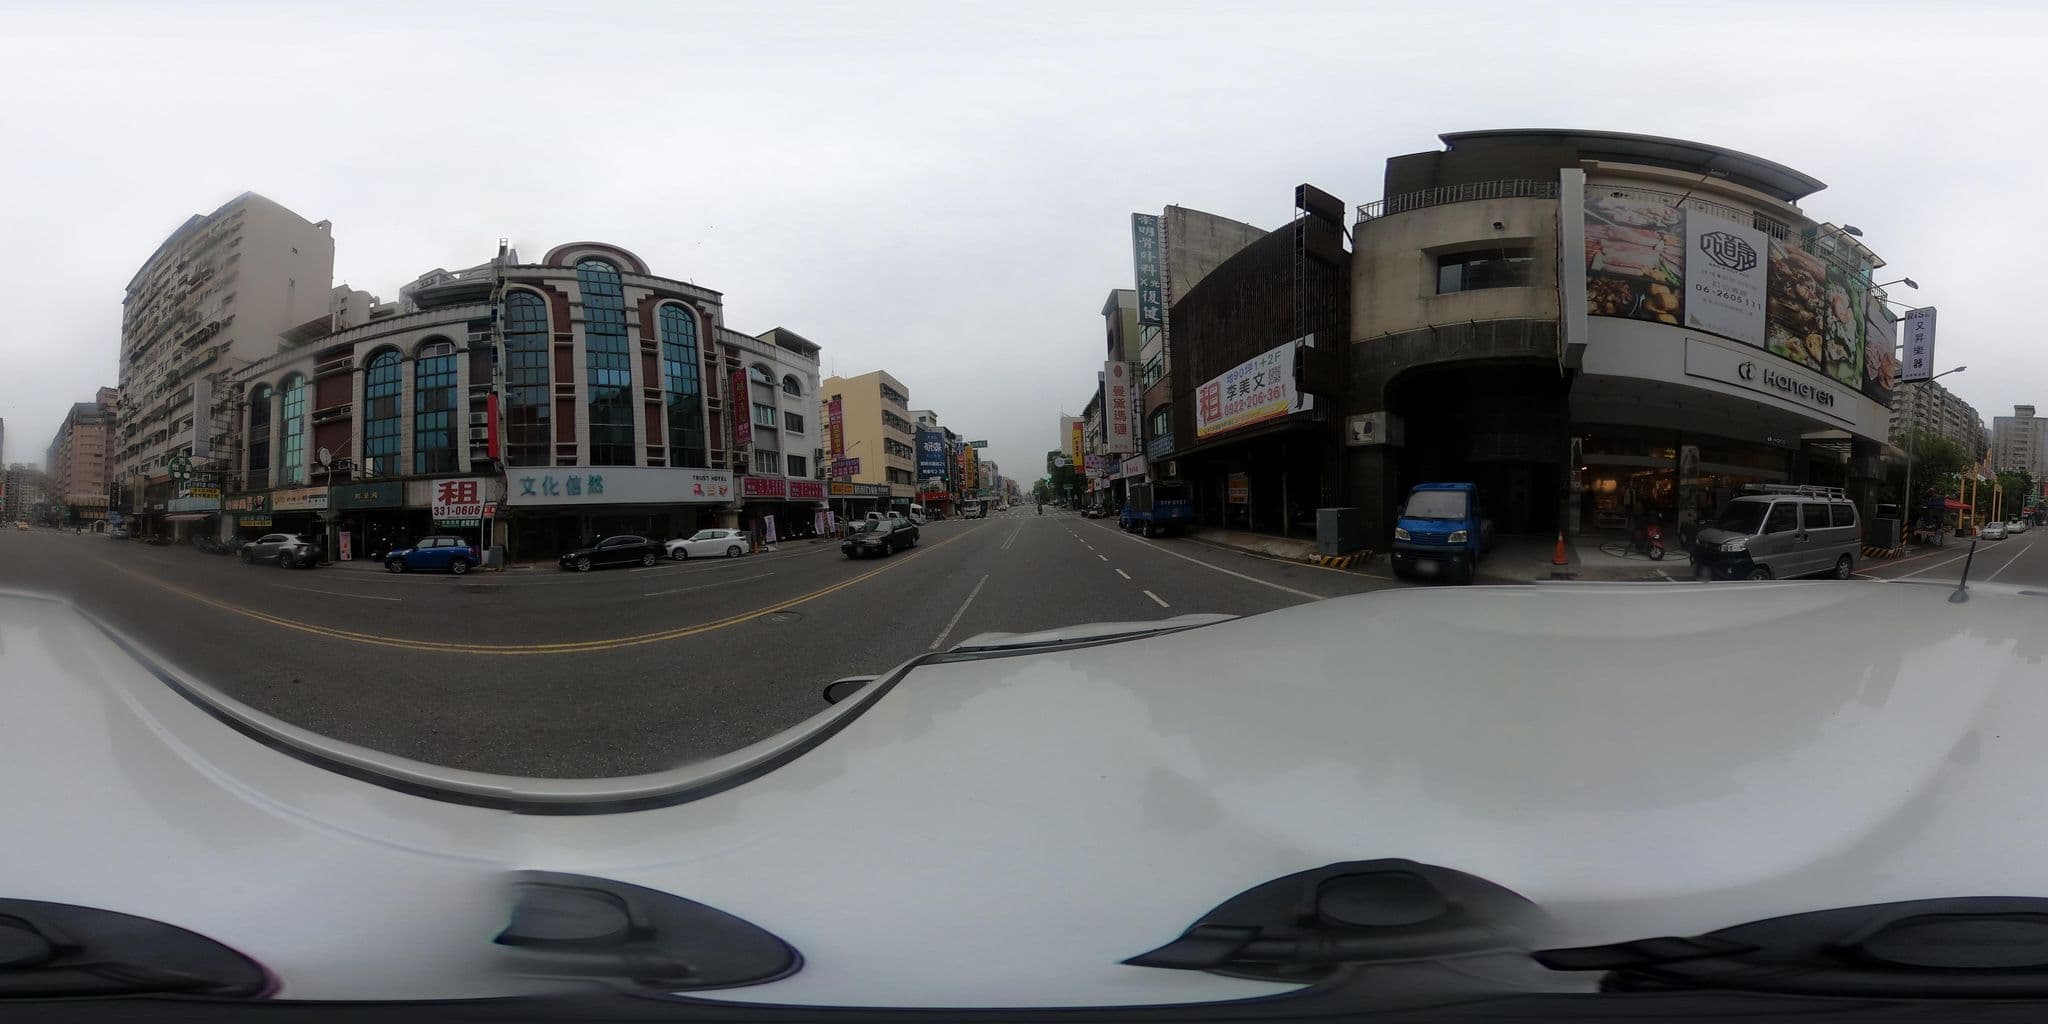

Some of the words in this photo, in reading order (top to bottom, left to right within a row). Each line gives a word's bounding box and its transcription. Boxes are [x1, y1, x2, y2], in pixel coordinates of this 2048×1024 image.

[1226, 372, 1265, 401] 李美文
[1200, 381, 1221, 424] 租
[438, 481, 480, 505] 租
[434, 505, 480, 516] 331-0606
